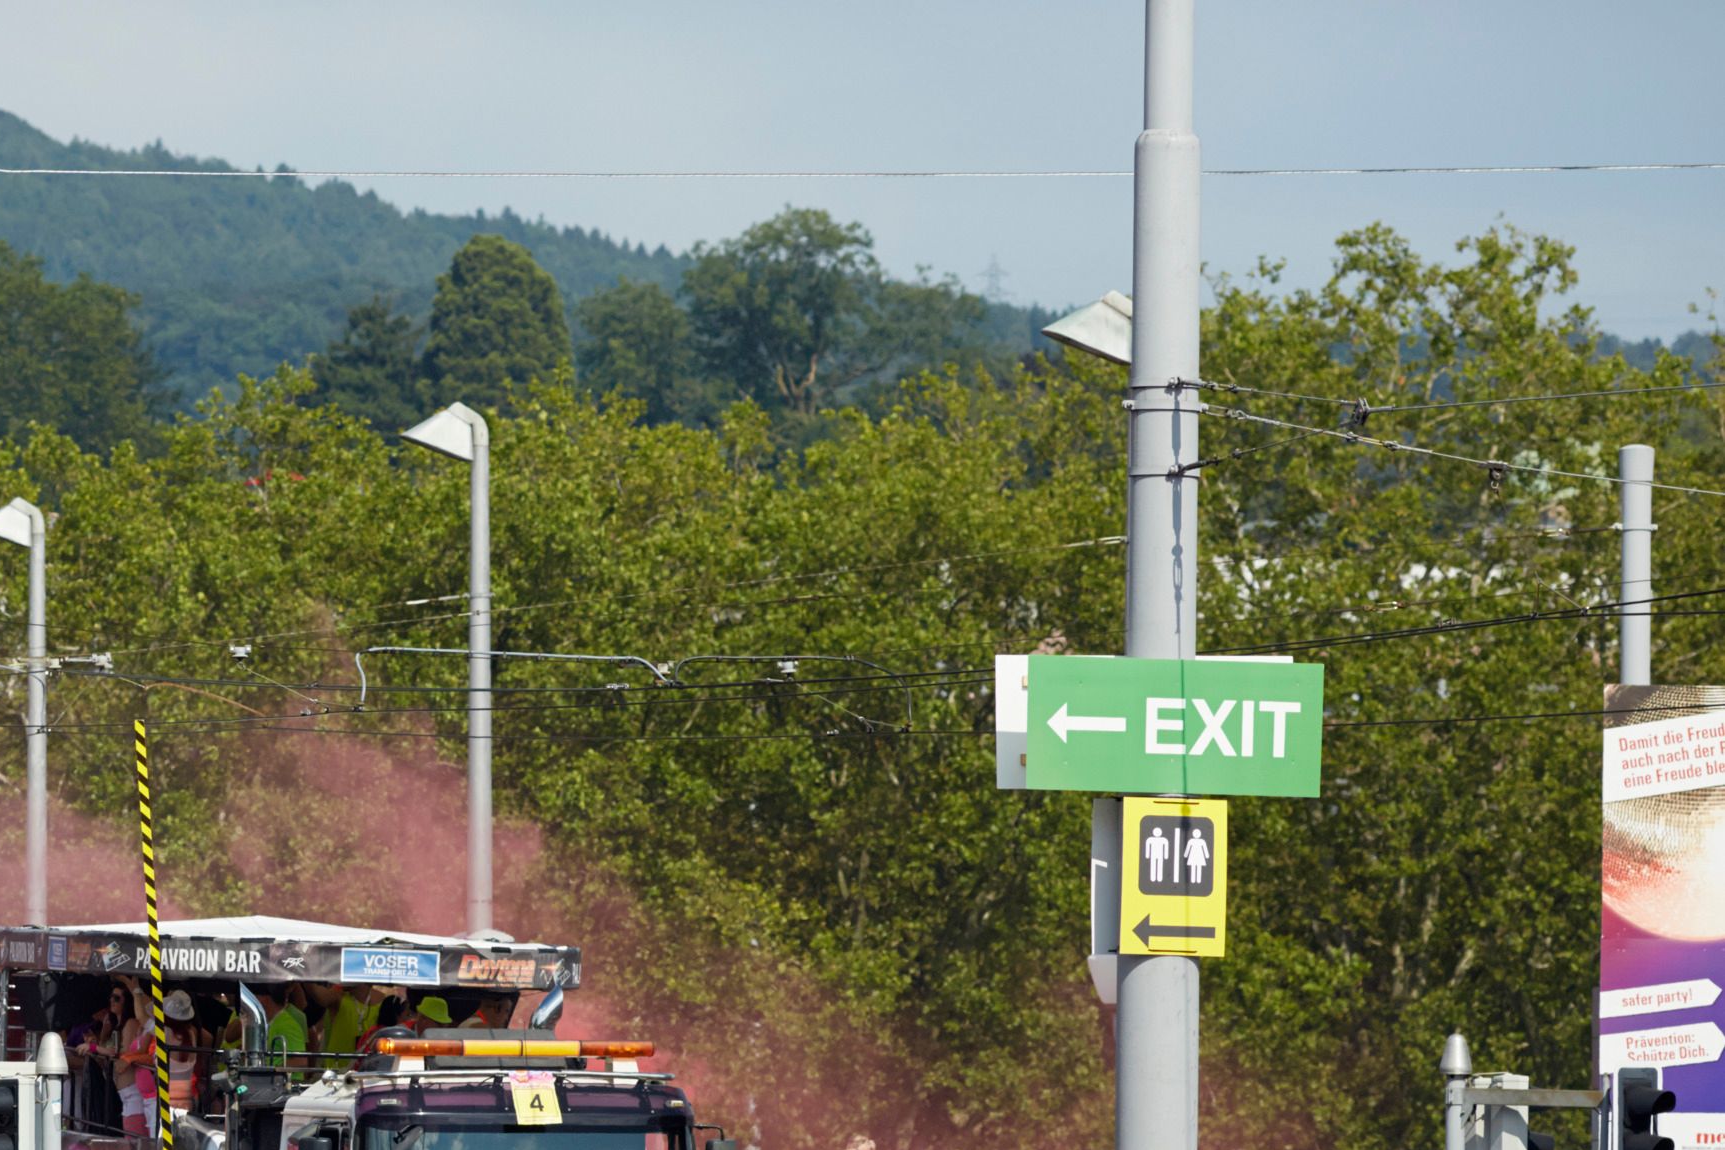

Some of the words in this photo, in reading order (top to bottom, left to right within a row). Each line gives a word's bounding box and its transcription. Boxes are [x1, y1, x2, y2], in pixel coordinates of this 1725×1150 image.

[1145, 697, 1301, 758] EXIT
[1619, 734, 1659, 752] Damit
[1663, 731, 1683, 745] die
[1621, 752, 1653, 770] auch
[1657, 747, 1689, 764] nach
[1694, 744, 1715, 759] der
[1624, 773, 1652, 788] eine
[1656, 763, 1702, 783] Freude
[135, 946, 219, 971] PAAVRION
[225, 950, 261, 973] BAR
[363, 954, 419, 969] VOSER
[363, 968, 405, 976] TRANSPORT
[407, 969, 419, 977] AG
[1622, 993, 1652, 1007] safer
[1657, 988, 1693, 1006] party!
[1626, 1034, 1695, 1049] Prävention:
[1679, 1046, 1709, 1060] Dich.
[530, 1094, 544, 1112] 4
